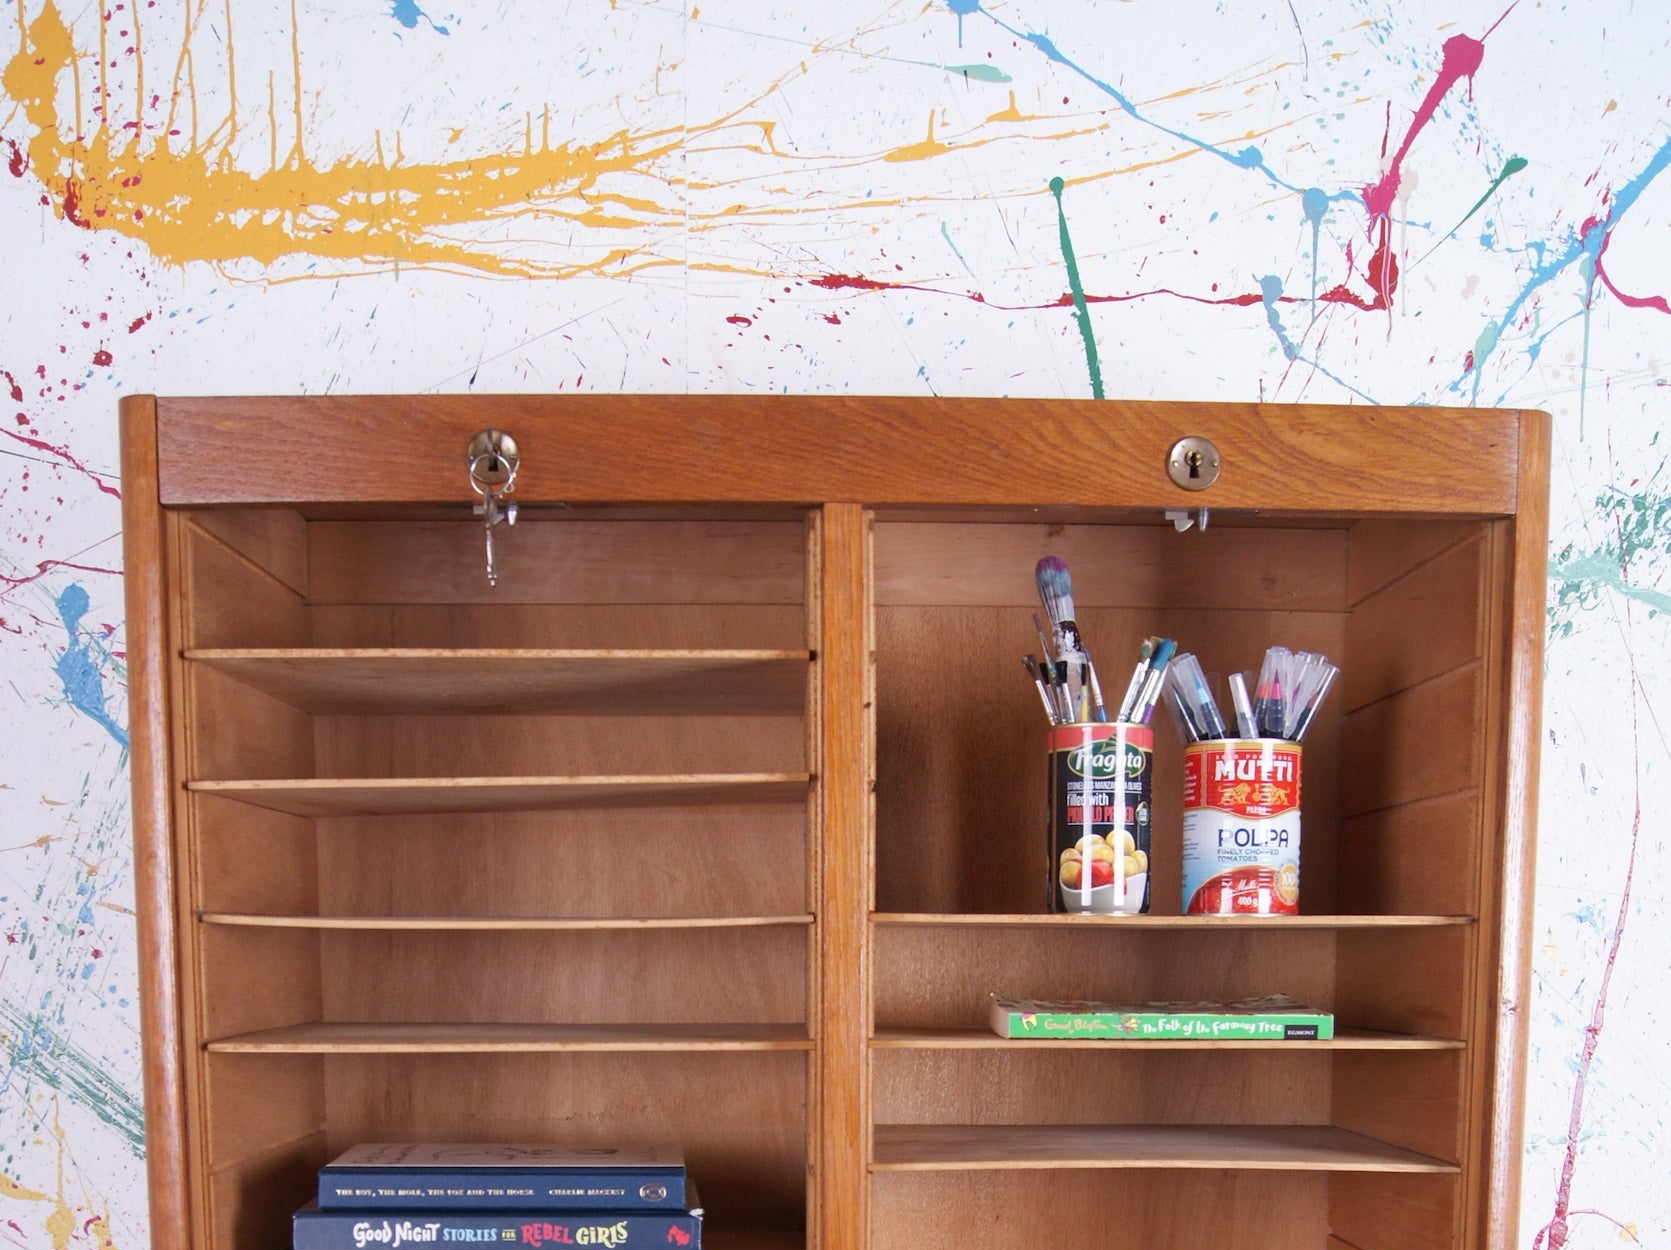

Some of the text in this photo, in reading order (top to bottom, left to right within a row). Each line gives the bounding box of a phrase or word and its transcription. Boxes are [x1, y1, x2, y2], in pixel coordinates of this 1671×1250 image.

[1073, 745, 1142, 772] Fragta
[1215, 760, 1292, 782] MUTTI
[1104, 806, 1134, 822] PEER
[1218, 828, 1289, 847] POLPA
[1237, 896, 1252, 905] 400
[1044, 1018, 1108, 1032] Enid Blyton
[1143, 1018, 1283, 1035] The Folk of the Faraway Tree
[397, 1188, 426, 1197] MOLE,
[353, 1220, 392, 1248] GOOD
[443, 1228, 497, 1242] STORIES
[502, 1230, 516, 1239] FOR
[521, 1222, 574, 1248] REBEL
